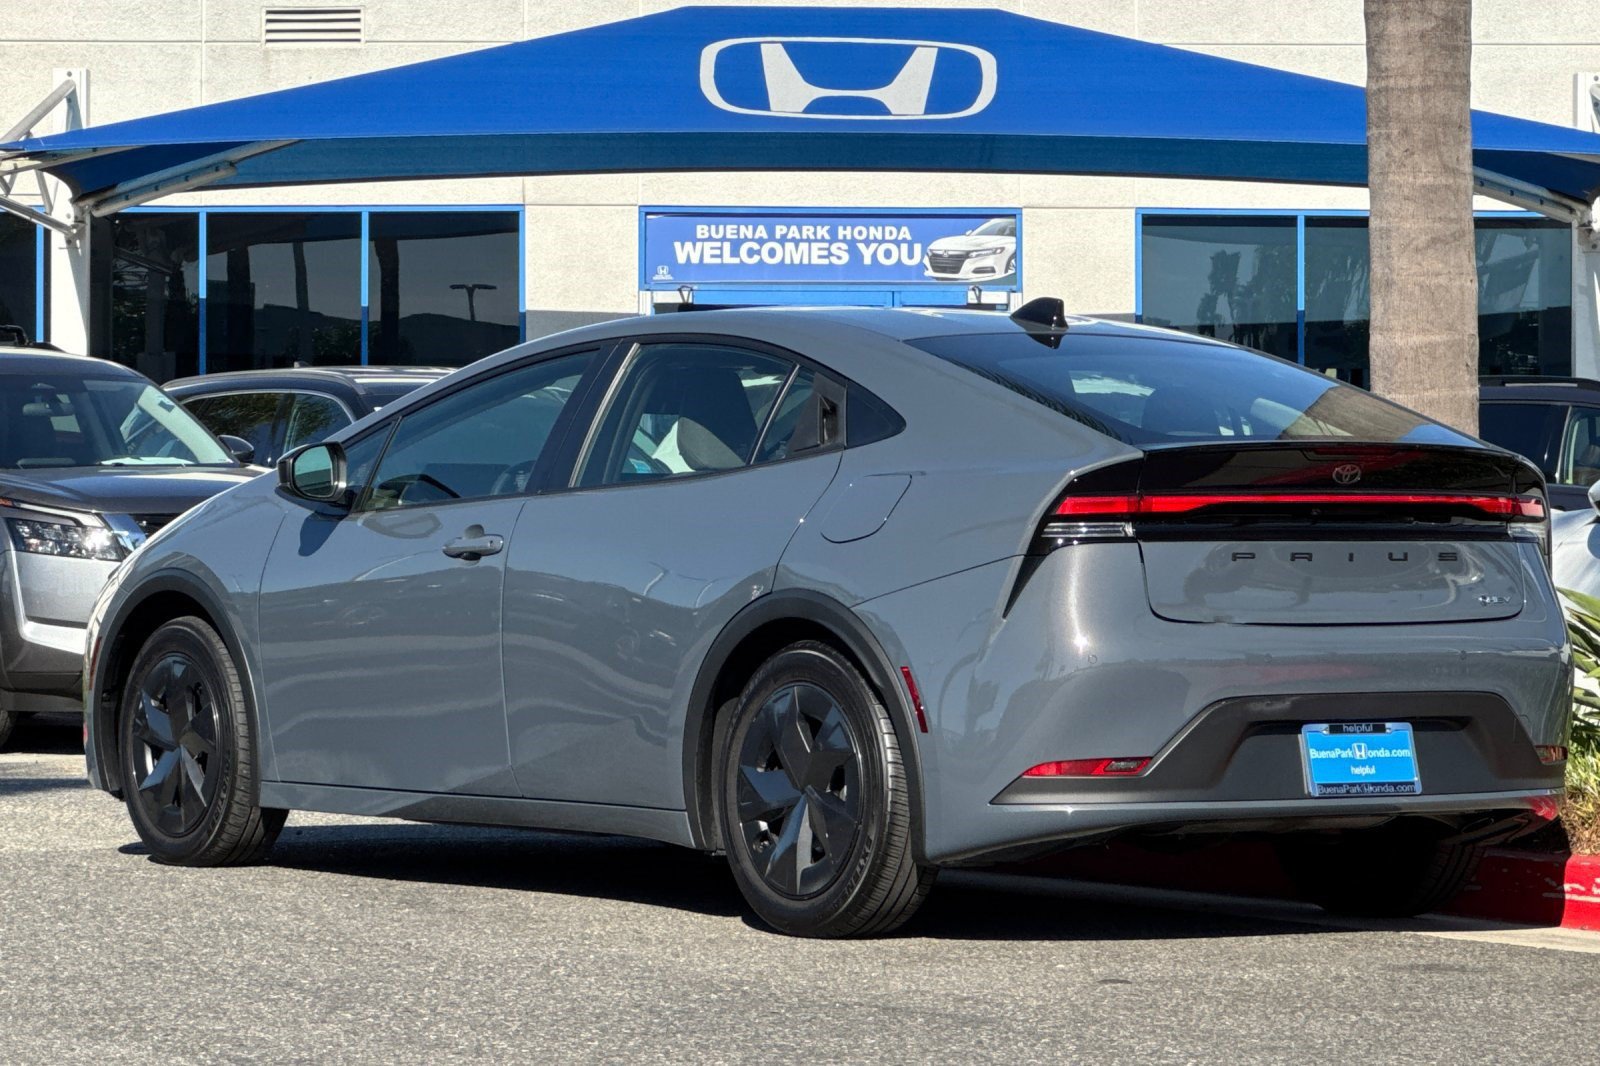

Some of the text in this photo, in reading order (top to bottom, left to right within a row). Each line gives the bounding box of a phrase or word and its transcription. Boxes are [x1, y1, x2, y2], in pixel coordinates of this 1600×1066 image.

[696, 224, 912, 241] BUENA PARK HONDA
[673, 240, 849, 264] WELCOMES
[1231, 551, 1459, 562] PRIUS
[1343, 723, 1373, 734] helpful
[1350, 766, 1376, 776] helpful
